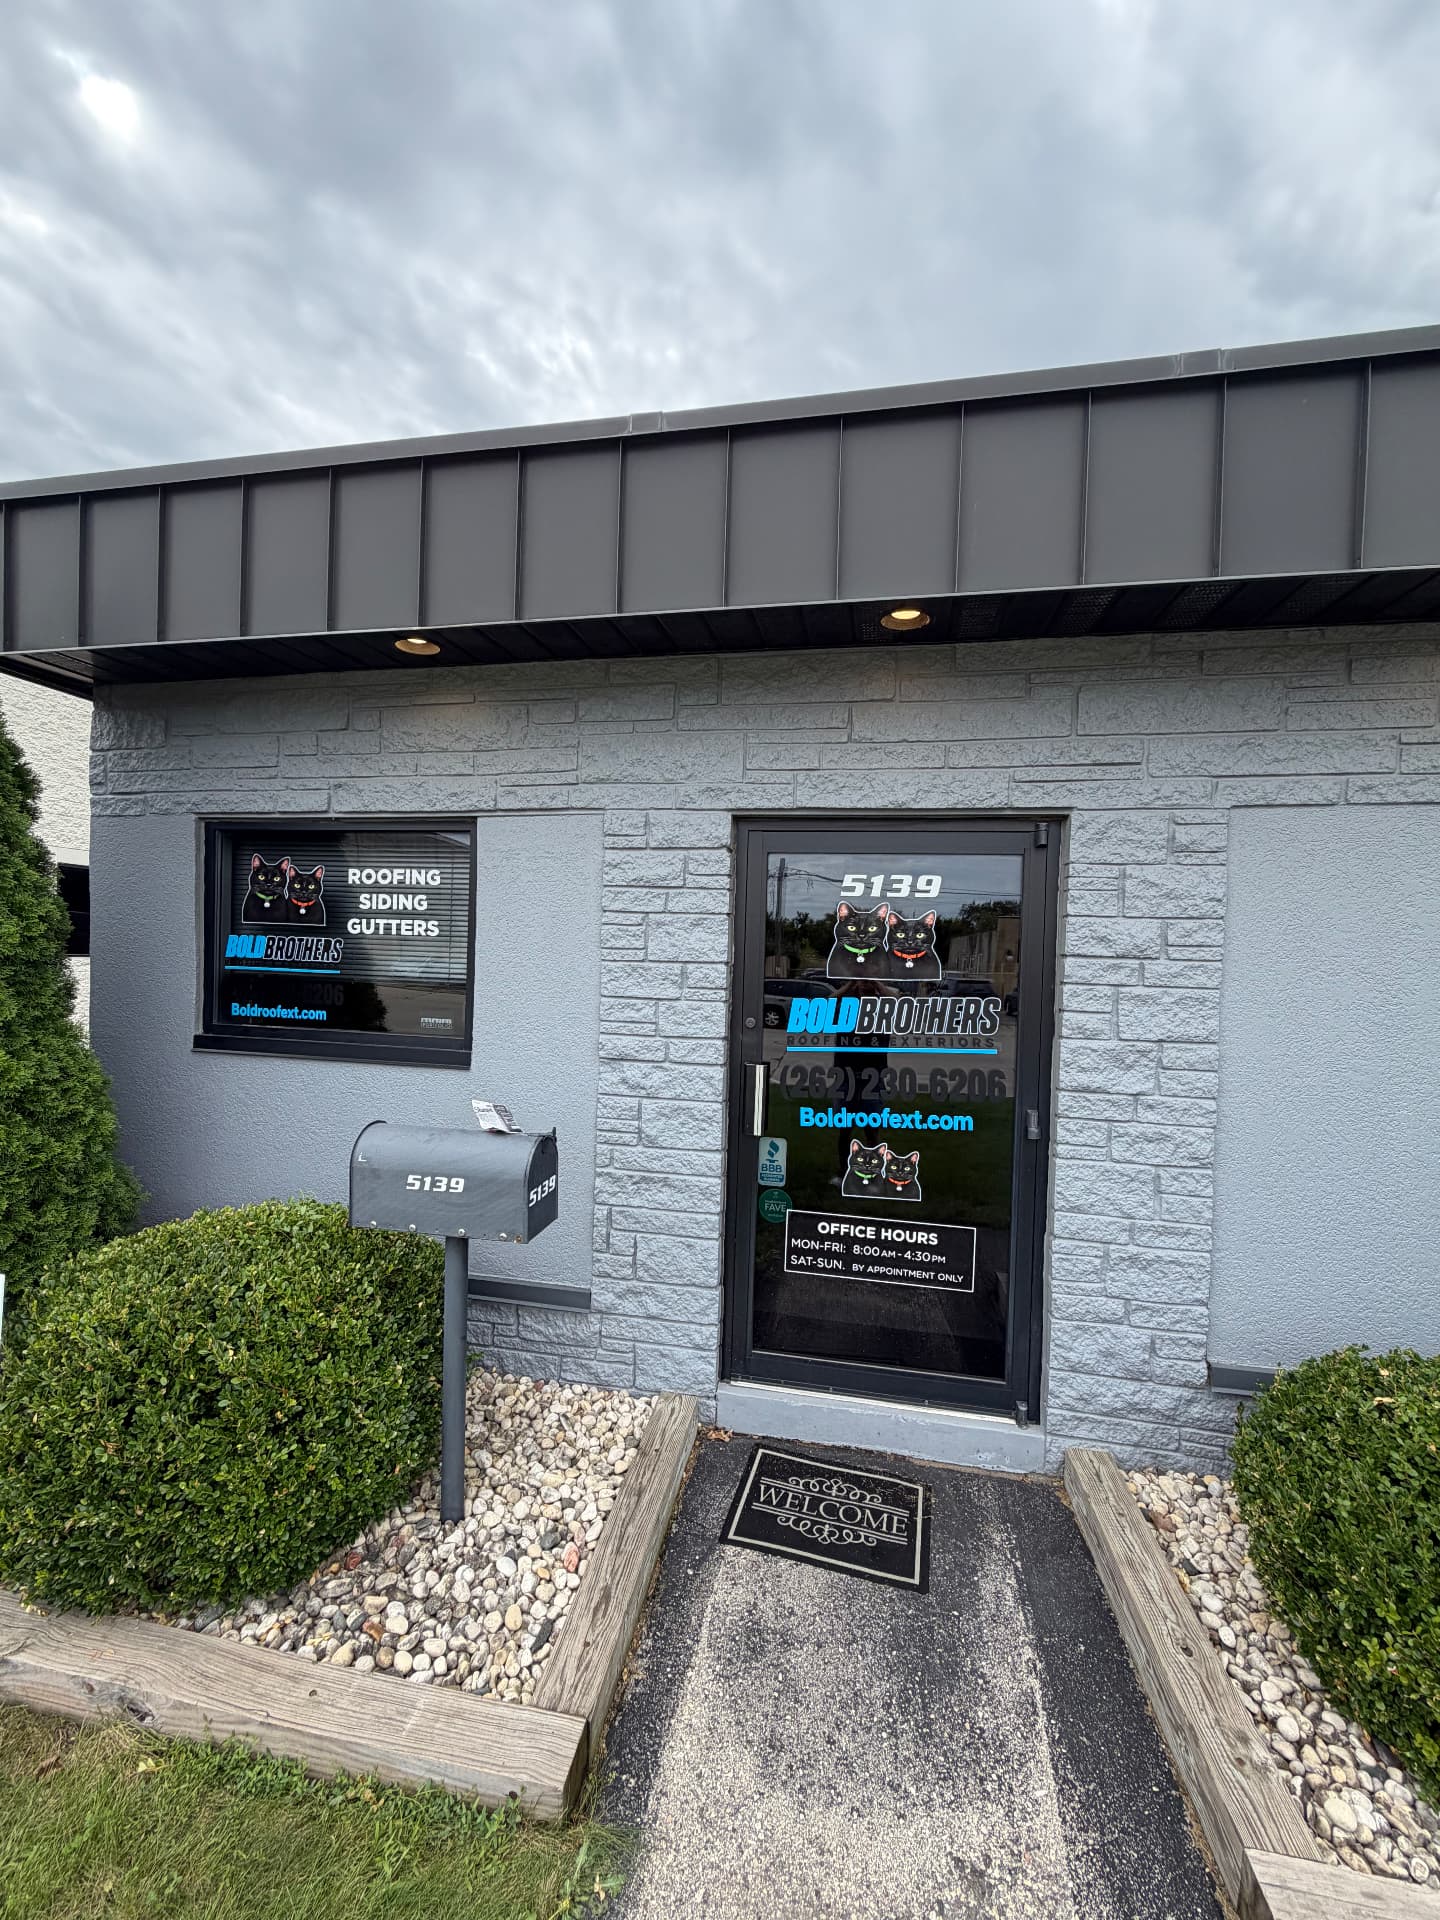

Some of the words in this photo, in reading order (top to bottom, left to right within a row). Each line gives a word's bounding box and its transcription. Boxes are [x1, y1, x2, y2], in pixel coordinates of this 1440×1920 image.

[347, 868, 441, 886] ROOFING
[840, 874, 942, 898] 5139
[359, 893, 428, 911] SIDING
[347, 918, 440, 937] GUTTERS
[231, 1003, 327, 1021] Boldroofext.com
[787, 1035, 862, 1046] ROOFING
[870, 1036, 880, 1047] &
[889, 1035, 995, 1048] EXTERIORS
[799, 1107, 974, 1132] Boldroofext.com
[761, 1163, 783, 1173] BBB
[406, 1174, 465, 1193] 5139
[528, 1174, 557, 1208] 5139
[764, 1202, 787, 1213] FAVE
[817, 1221, 876, 1240] OFFICE
[880, 1227, 938, 1246] HOURS
[791, 1238, 847, 1254] MON-FRI:
[790, 1255, 846, 1271] SAT-SUN.
[852, 1263, 865, 1272] BY
[866, 1264, 935, 1281] APPOINTMENT
[937, 1273, 964, 1284] ONLY
[758, 1483, 909, 1537] WELCOME
